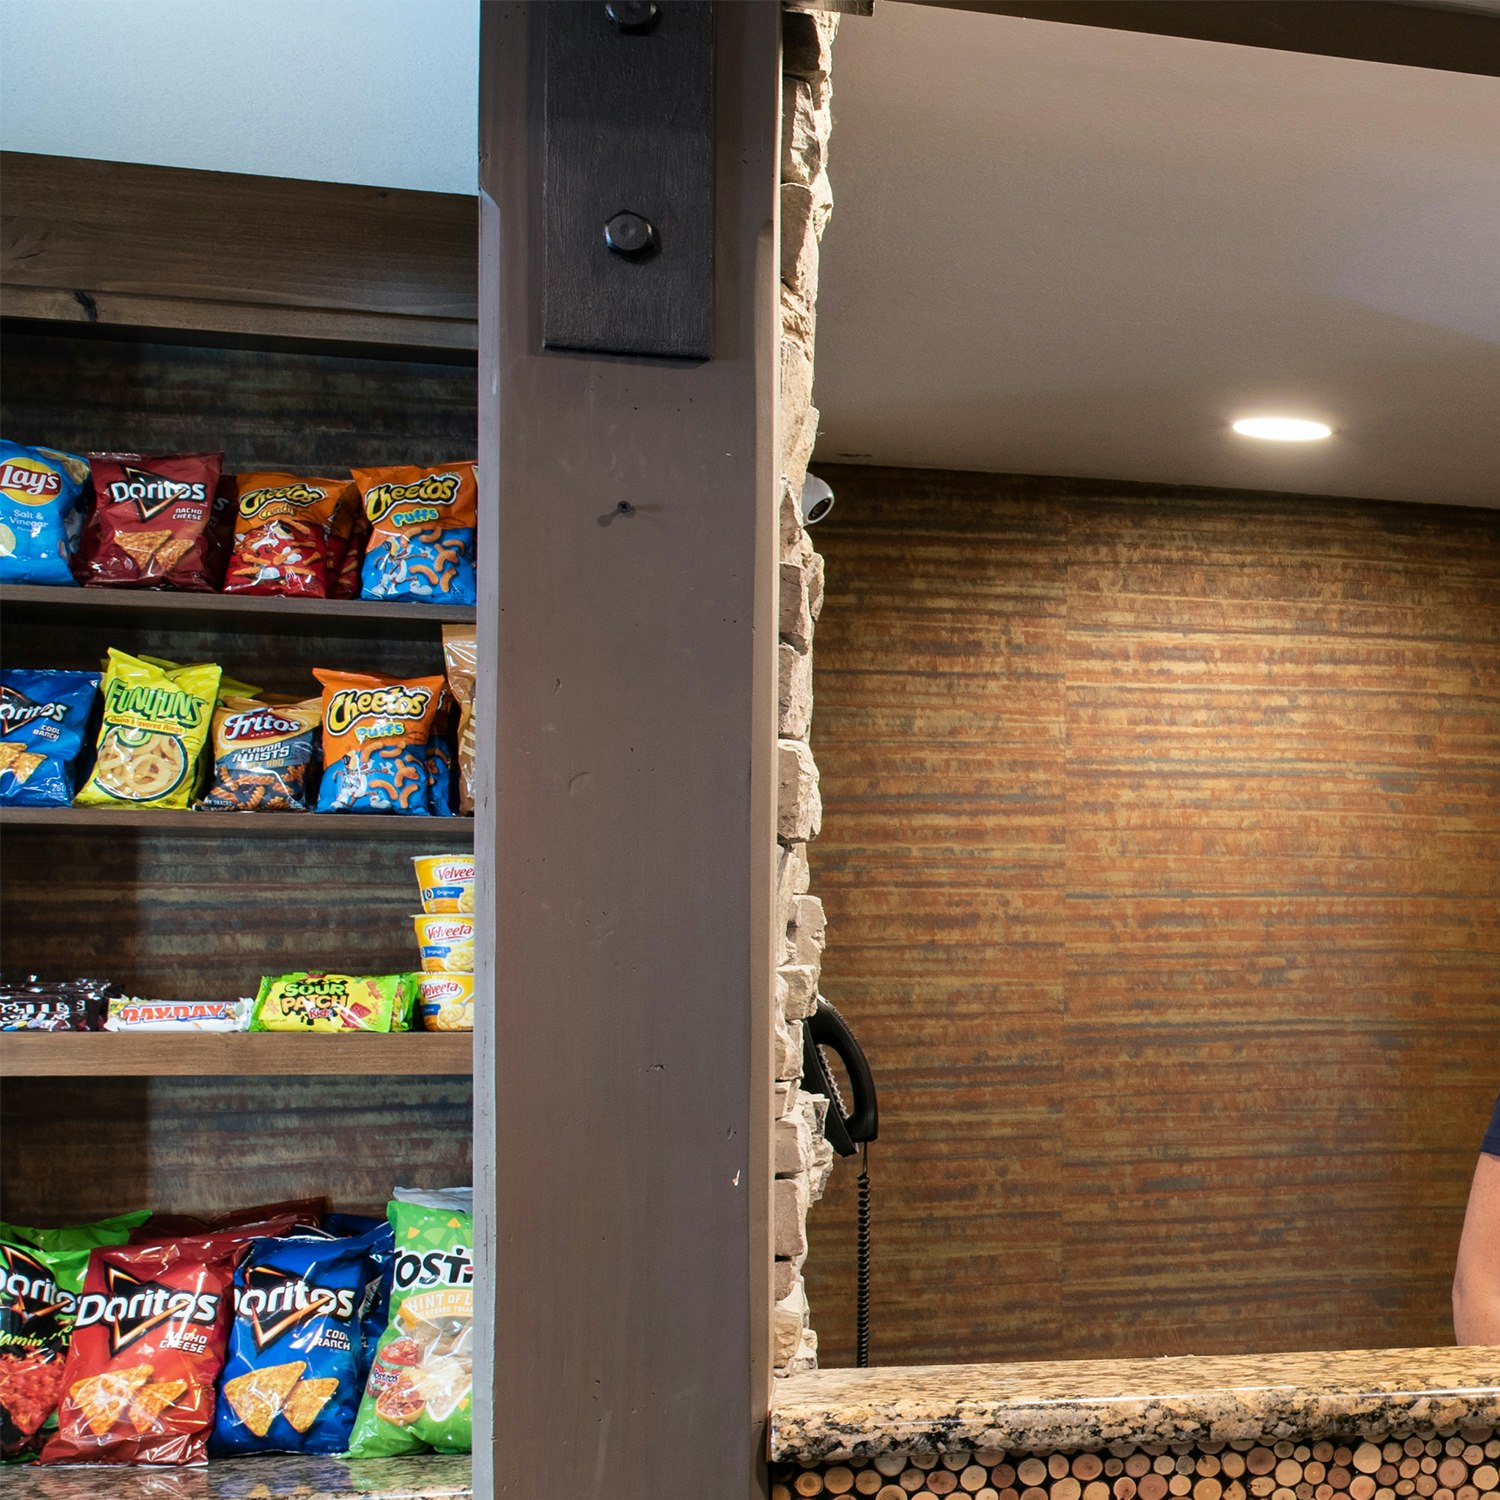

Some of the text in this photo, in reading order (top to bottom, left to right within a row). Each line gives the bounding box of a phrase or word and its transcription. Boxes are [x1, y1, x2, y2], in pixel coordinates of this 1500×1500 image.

[1, 466, 59, 494] Lay's
[110, 478, 206, 503] Doritos
[240, 484, 321, 517] Cheetos
[366, 475, 460, 522] Cheetos
[9, 516, 49, 529] Vinegar
[13, 509, 33, 519] Salt
[392, 507, 439, 527] Puffs
[0, 702, 67, 721] oritos
[328, 686, 429, 734] Cheetos
[224, 707, 300, 740] Fritos
[438, 867, 475, 880] Velvee
[427, 925, 472, 939] Velveeta
[284, 983, 346, 996] SOUR
[281, 995, 347, 1013] PATCH
[0, 1270, 82, 1314] orito
[235, 1280, 356, 1318] oritos
[75, 1290, 219, 1327] Doritos
[159, 1339, 206, 1354] CHEESE
[315, 1337, 350, 1351] RANCH
